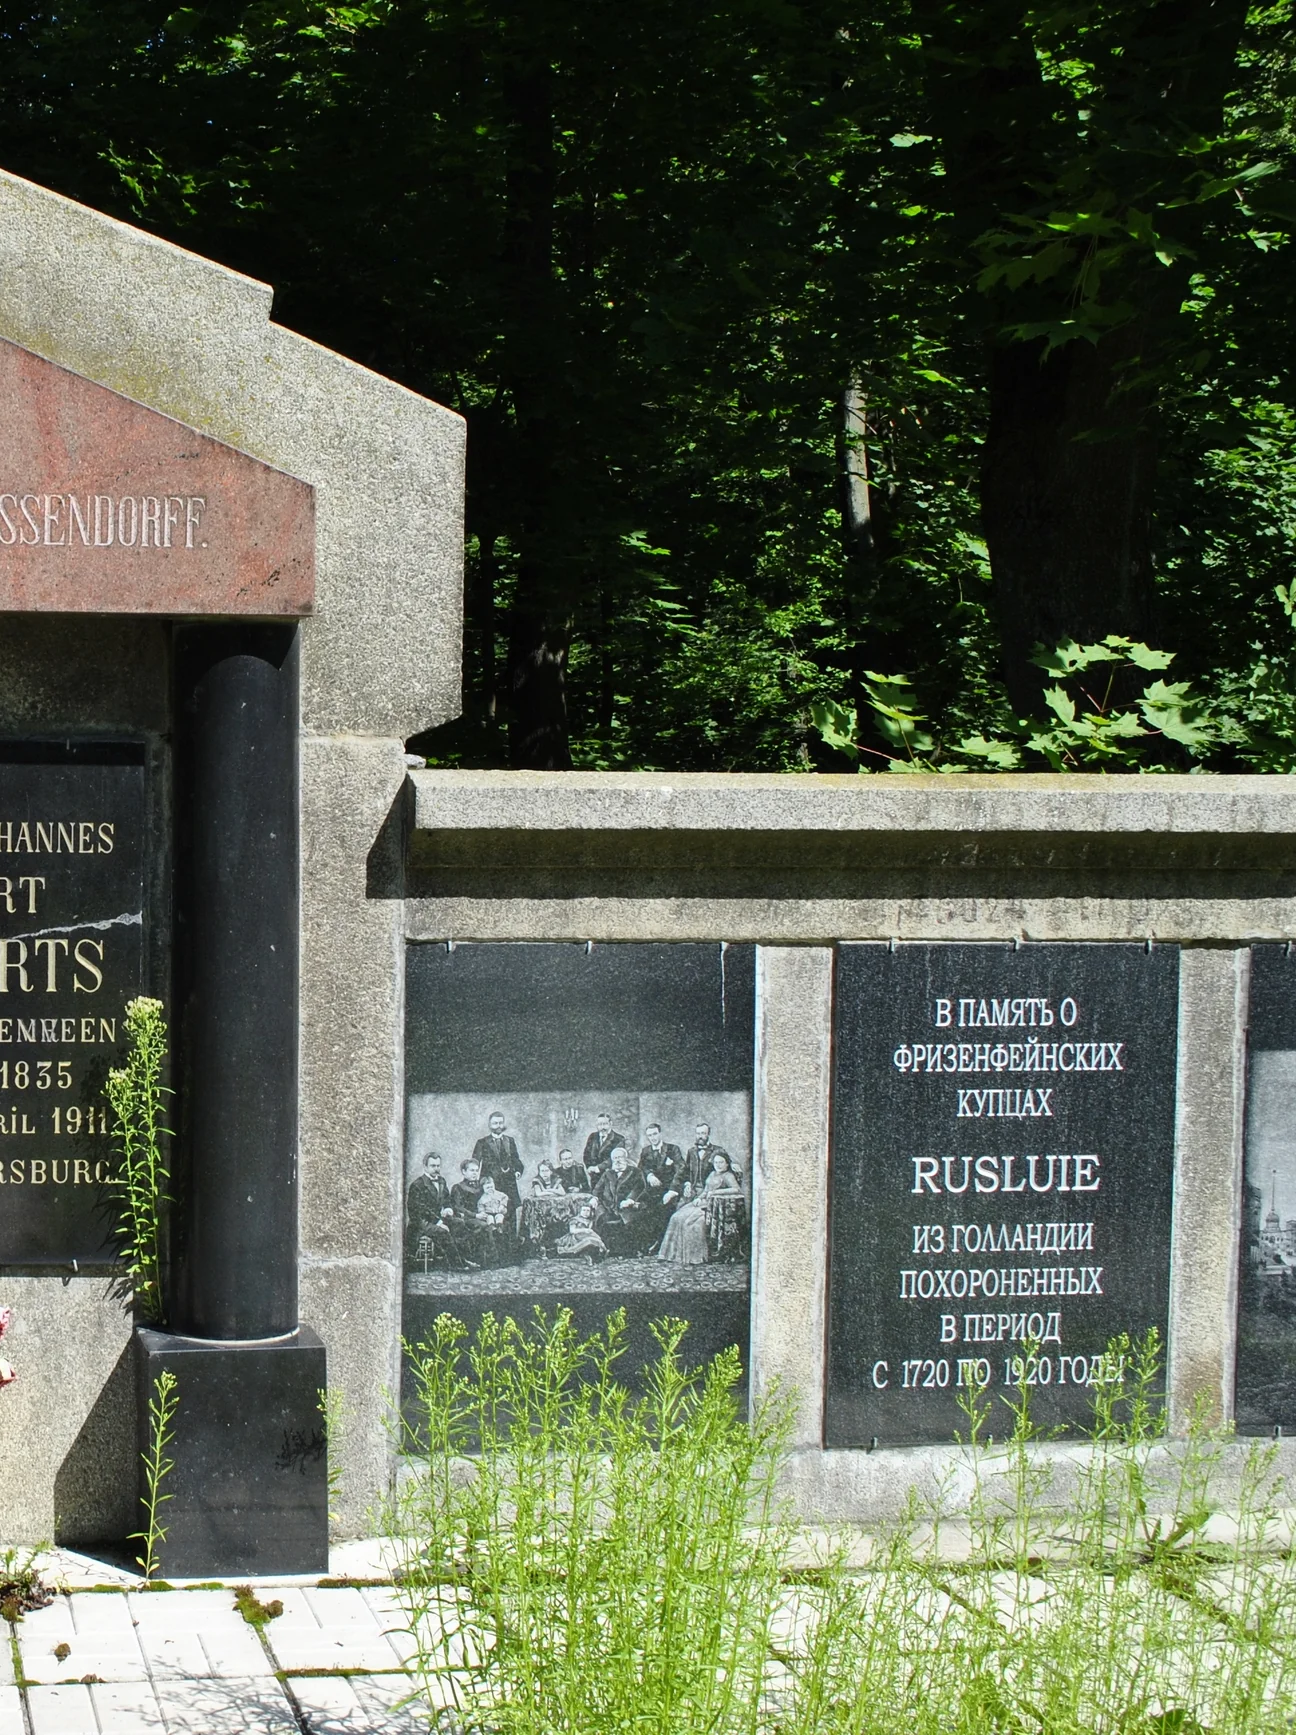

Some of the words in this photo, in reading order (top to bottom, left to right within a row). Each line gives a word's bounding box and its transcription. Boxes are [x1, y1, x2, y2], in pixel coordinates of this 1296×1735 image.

[935, 998, 952, 1028] В
[958, 997, 1055, 1028] ПАМЯТЬ
[1060, 996, 1078, 1027] О
[893, 1036, 1124, 1073] ФРИЗЕНФЕЙНСКИХ
[0, 1060, 72, 1090] 1835
[52, 1106, 106, 1134] 1911
[956, 1088, 1053, 1121] КУПЦАХ
[911, 1154, 1101, 1194] RUSLUIE
[912, 1224, 946, 1254] ИЗ
[951, 1222, 1095, 1256] ГОЛЛАНДИИ
[899, 1266, 1104, 1299] ПОХОРОНЕННЫХ
[940, 1314, 958, 1343] В
[963, 1311, 1062, 1345] ПЕРИОД
[872, 1360, 889, 1389] С
[902, 1359, 950, 1389] 1720
[956, 1357, 992, 1389] ПО
[1004, 1354, 1052, 1386] 1920
